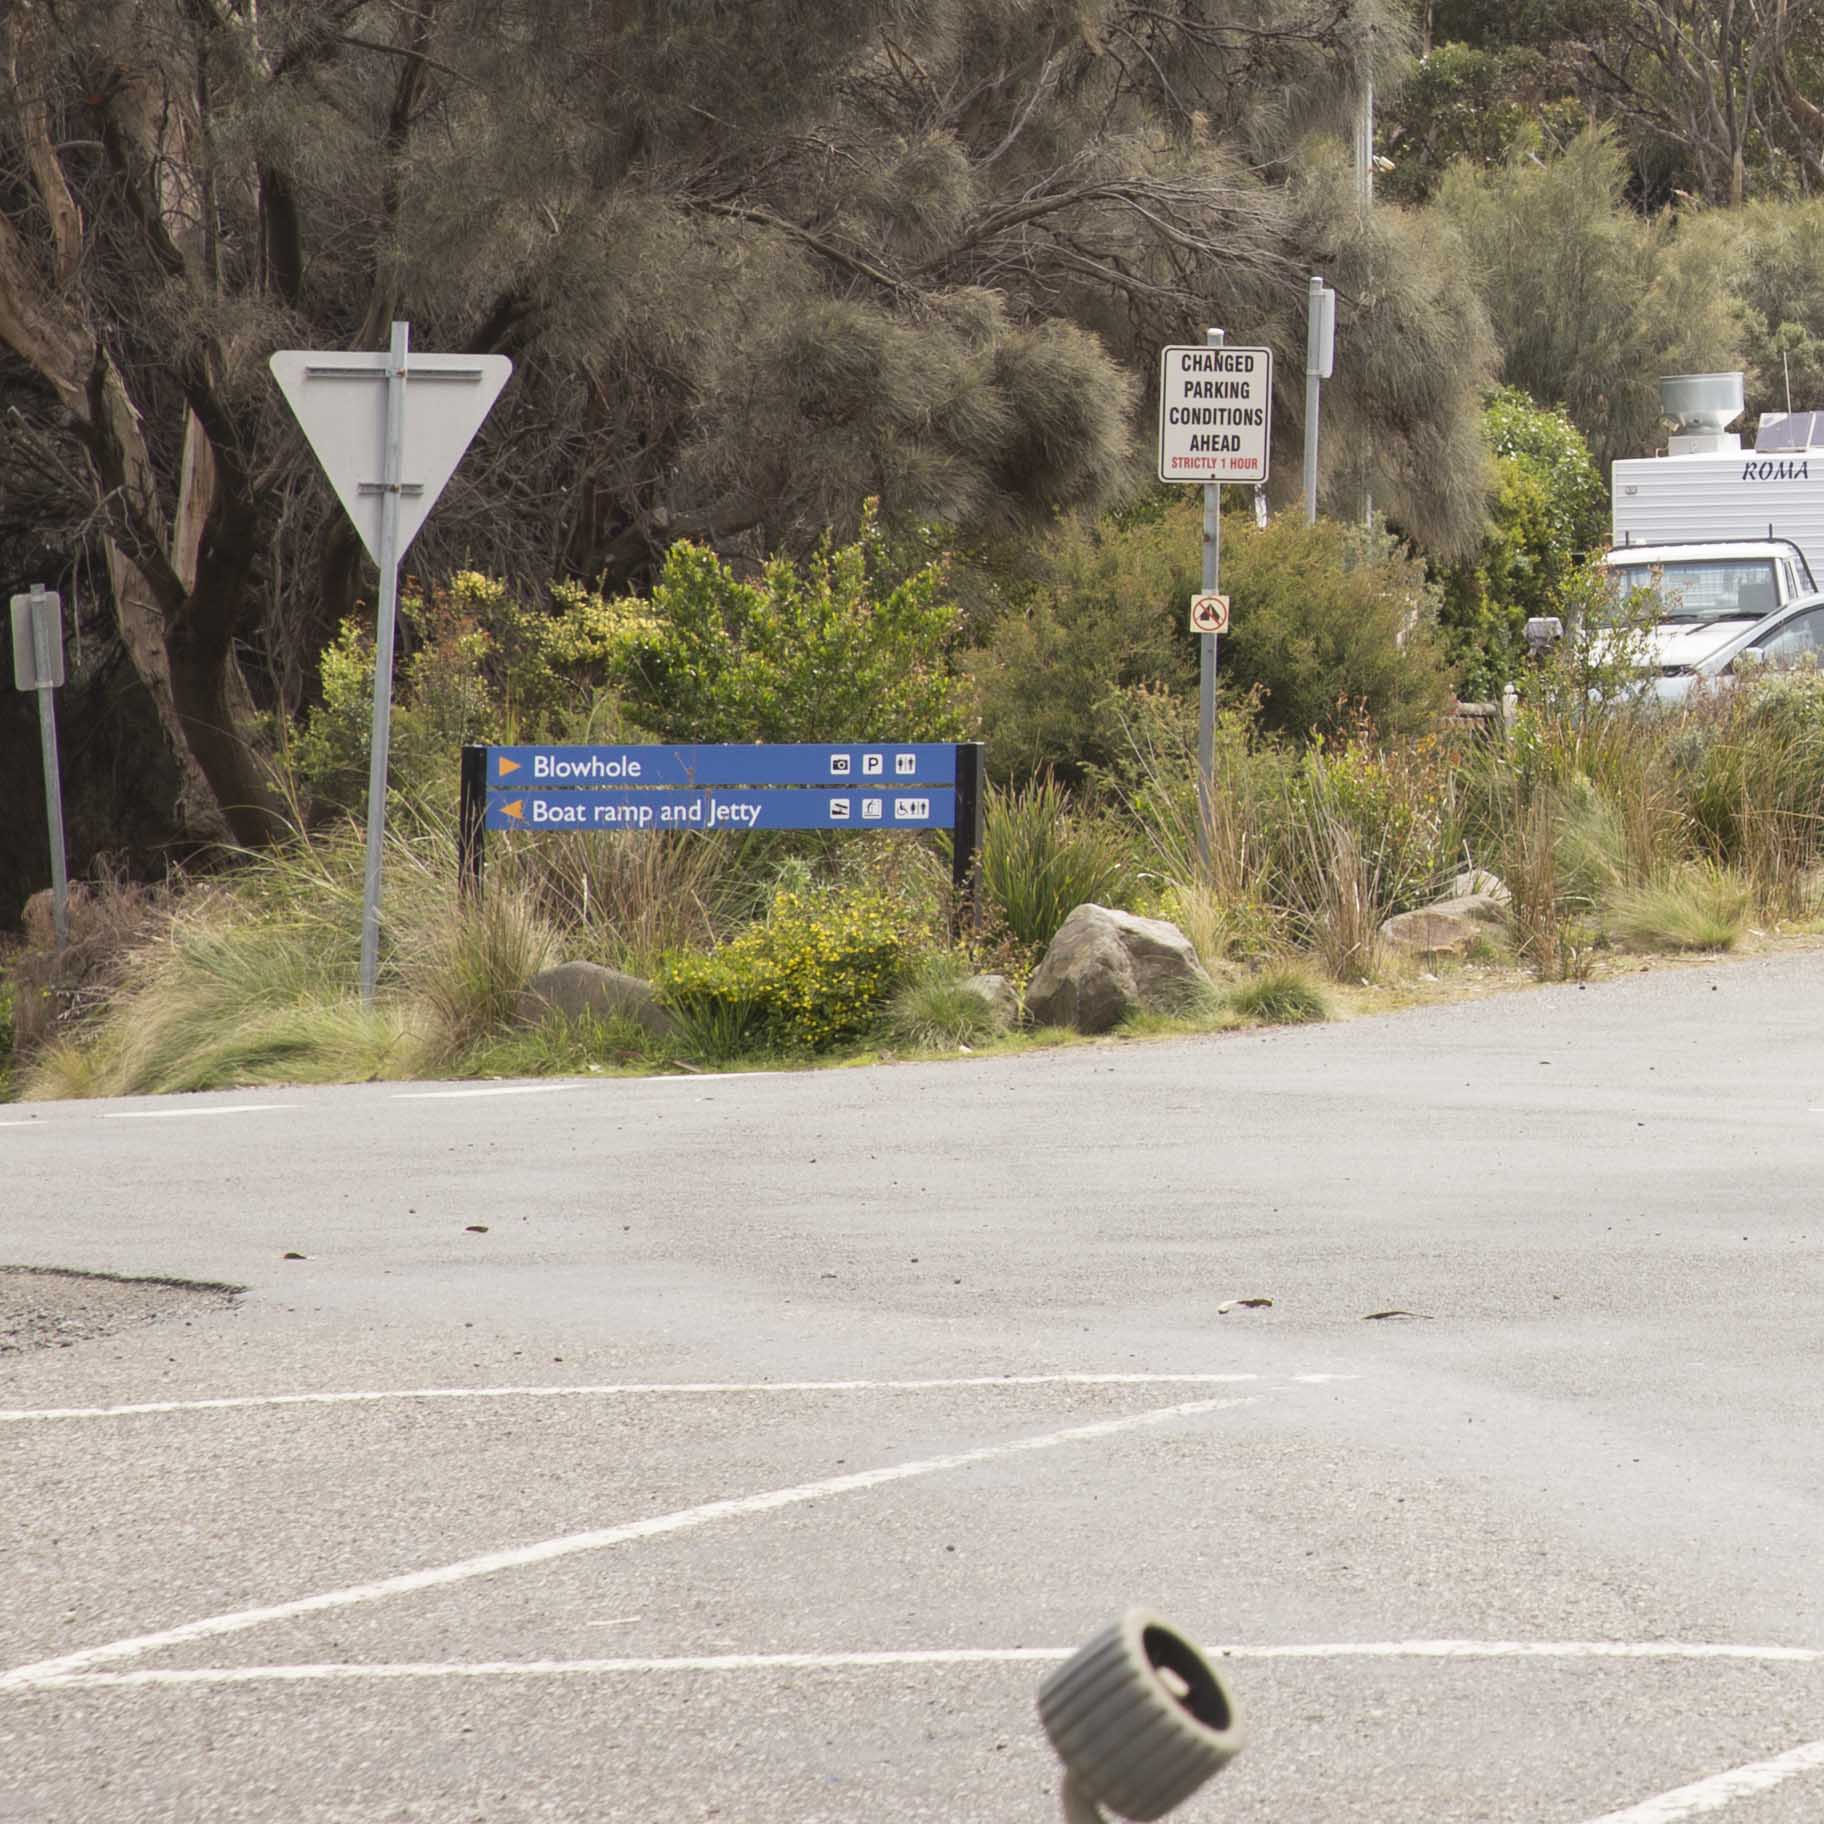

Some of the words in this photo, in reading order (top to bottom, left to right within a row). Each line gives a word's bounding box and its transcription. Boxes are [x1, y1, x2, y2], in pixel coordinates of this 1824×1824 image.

[1181, 354, 1254, 372] CHANGED
[1184, 381, 1250, 399] PARKING
[1169, 407, 1263, 426] CONDITIONS
[1189, 434, 1241, 452] AHEAD
[1171, 457, 1217, 469] STRICTLY
[1221, 458, 1226, 469] 1
[1230, 458, 1258, 470] HOUR
[1742, 461, 1808, 480] ROMA
[534, 755, 641, 777] Blowhole
[533, 800, 586, 822] Boat
[594, 805, 653, 827] ramp
[661, 800, 701, 821] and
[707, 799, 762, 827] Jetty
